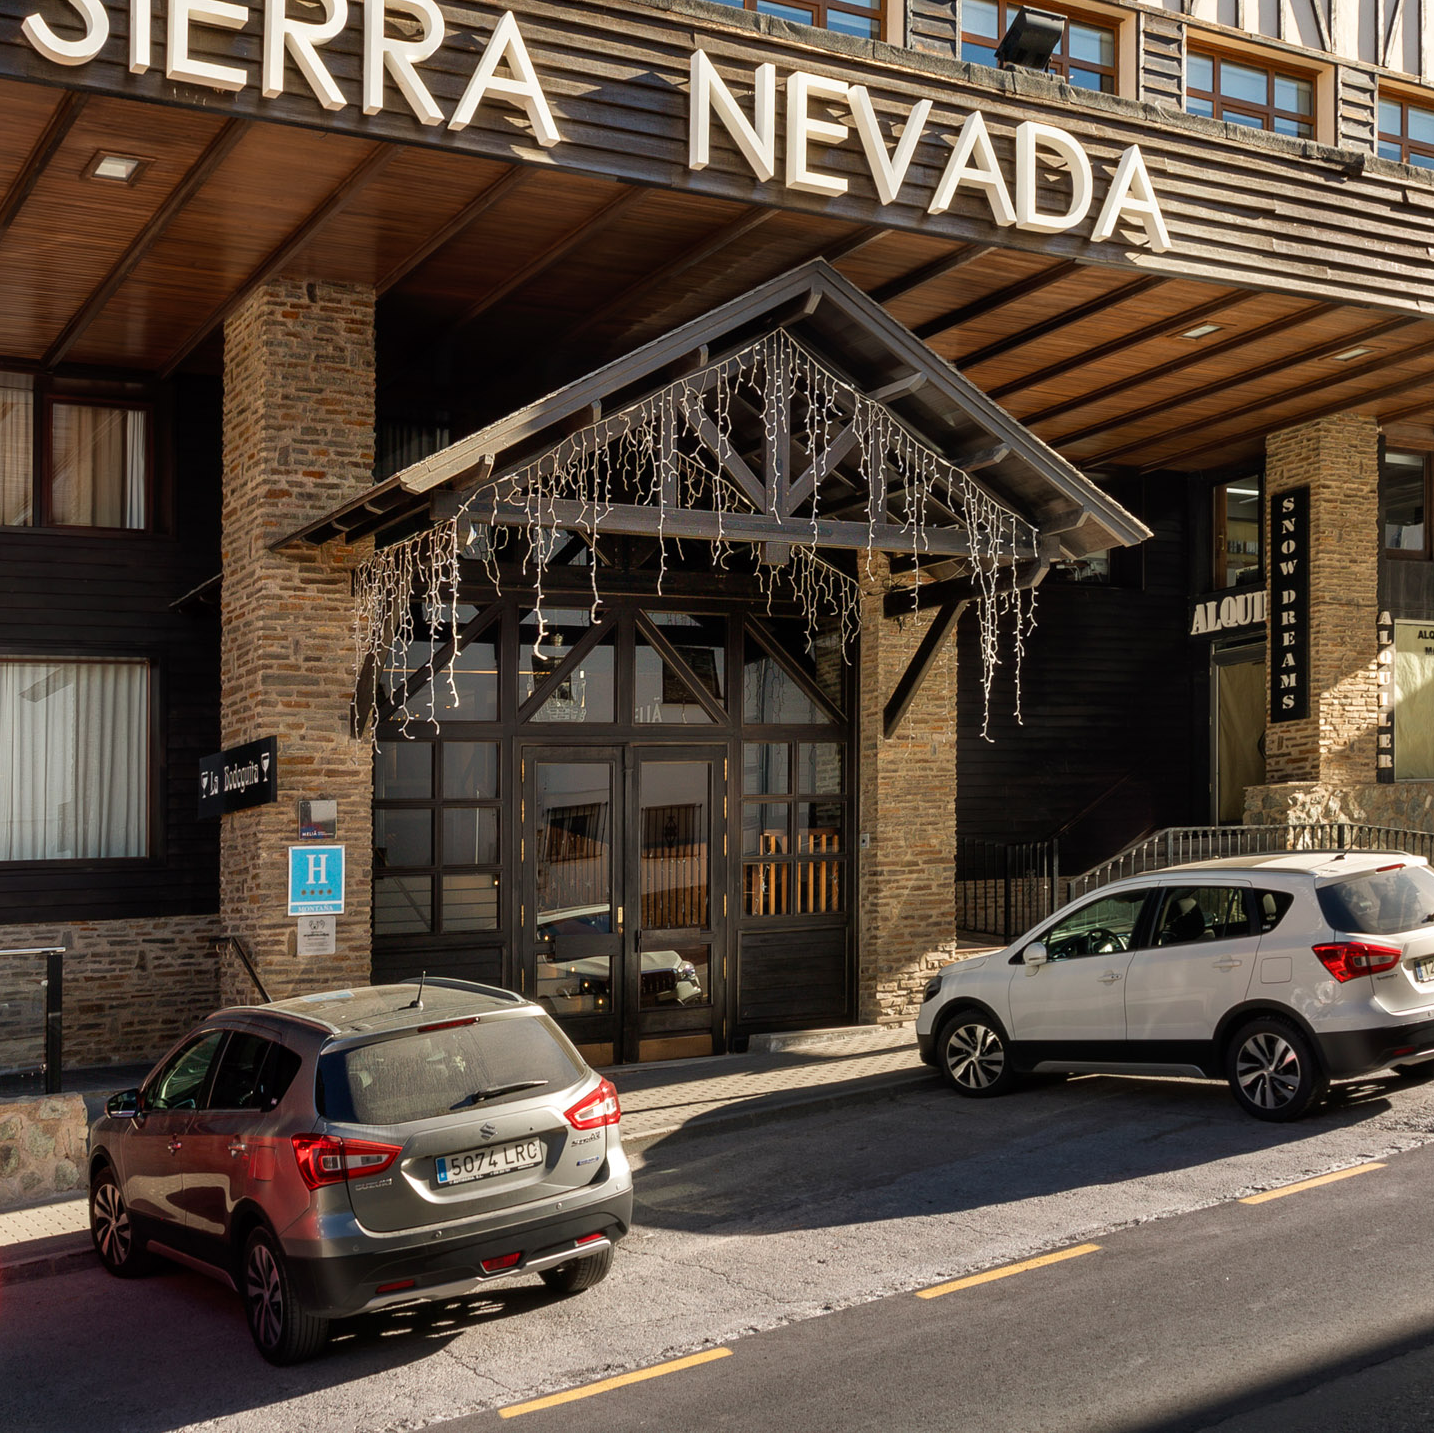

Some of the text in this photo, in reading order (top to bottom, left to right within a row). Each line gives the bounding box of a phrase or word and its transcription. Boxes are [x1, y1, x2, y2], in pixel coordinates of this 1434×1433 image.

[689, 49, 1172, 253] NEVADA
[1280, 497, 1298, 710] SNOW DREAMS
[1377, 611, 1393, 768] ALQUILER
[224, 760, 259, 793] Bodeguita
[306, 854, 328, 884] H
[298, 904, 333, 913] MONTAÑA
[451, 1150, 498, 1176] 5074
[503, 1142, 538, 1165] LRC
